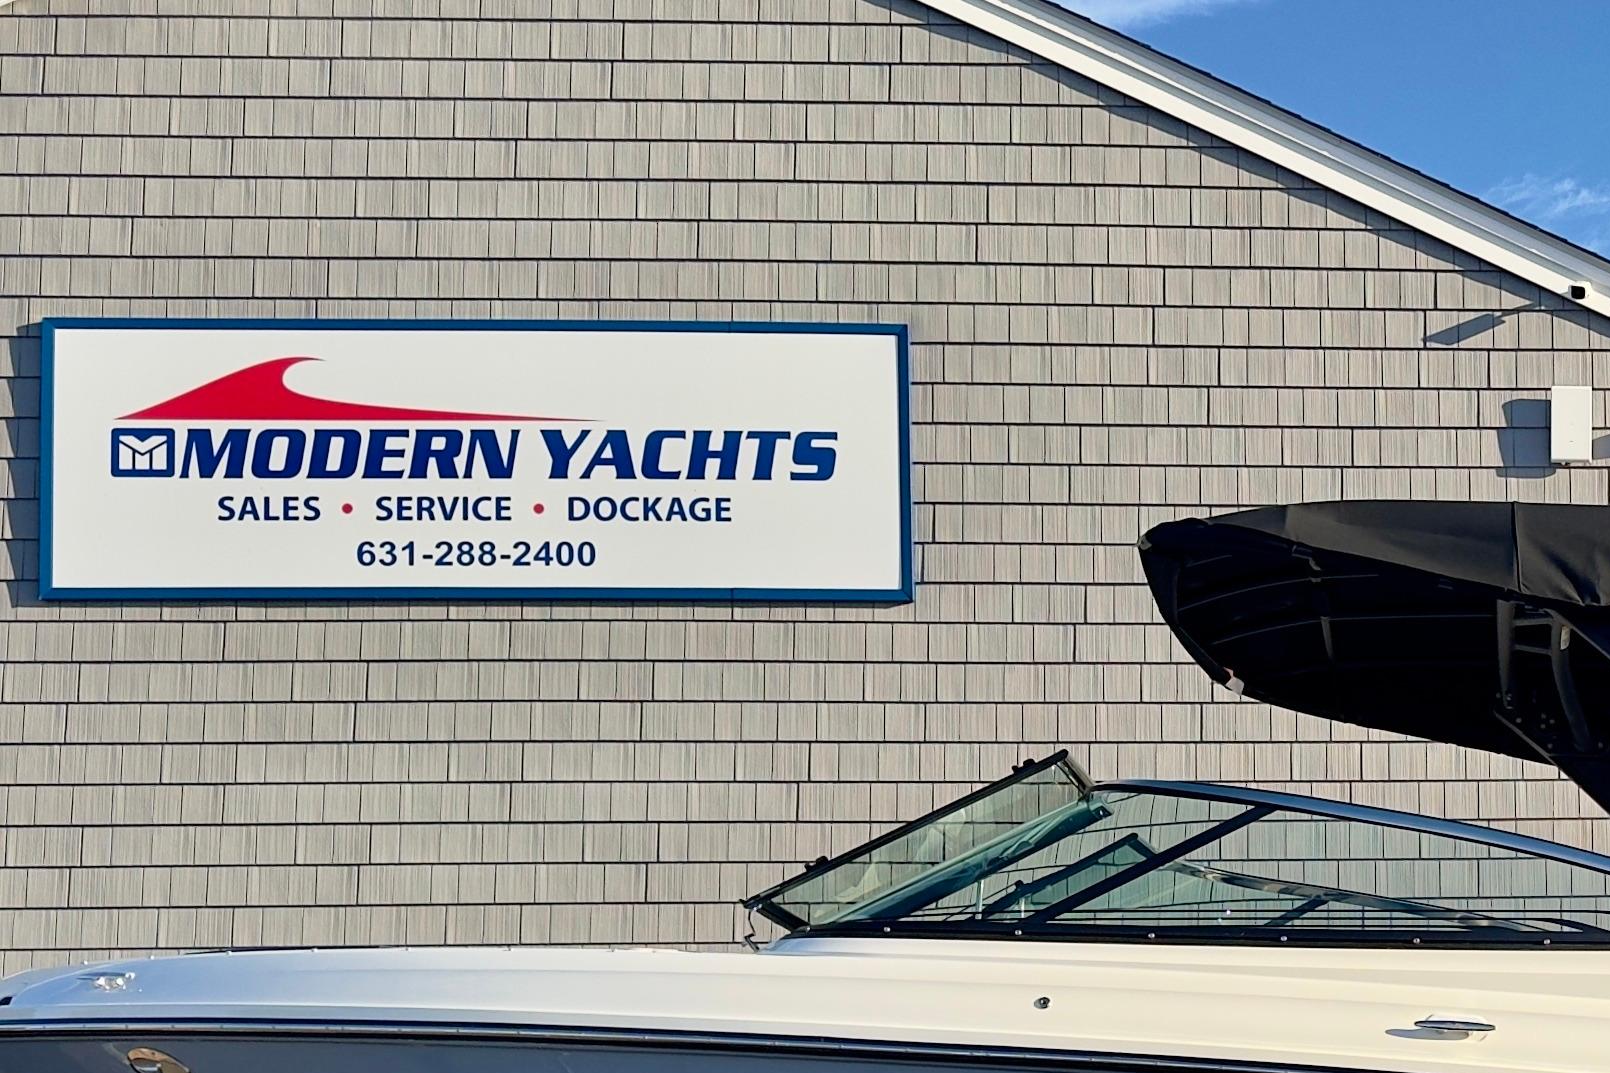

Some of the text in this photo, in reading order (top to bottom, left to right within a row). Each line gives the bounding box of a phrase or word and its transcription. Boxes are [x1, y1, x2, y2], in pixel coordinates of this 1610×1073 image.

[179, 429, 521, 480] MODERN
[540, 429, 838, 482] YACHTS
[217, 496, 732, 523] SALES SERVICE DOCKAGE
[356, 541, 596, 567] 631-288-2400
